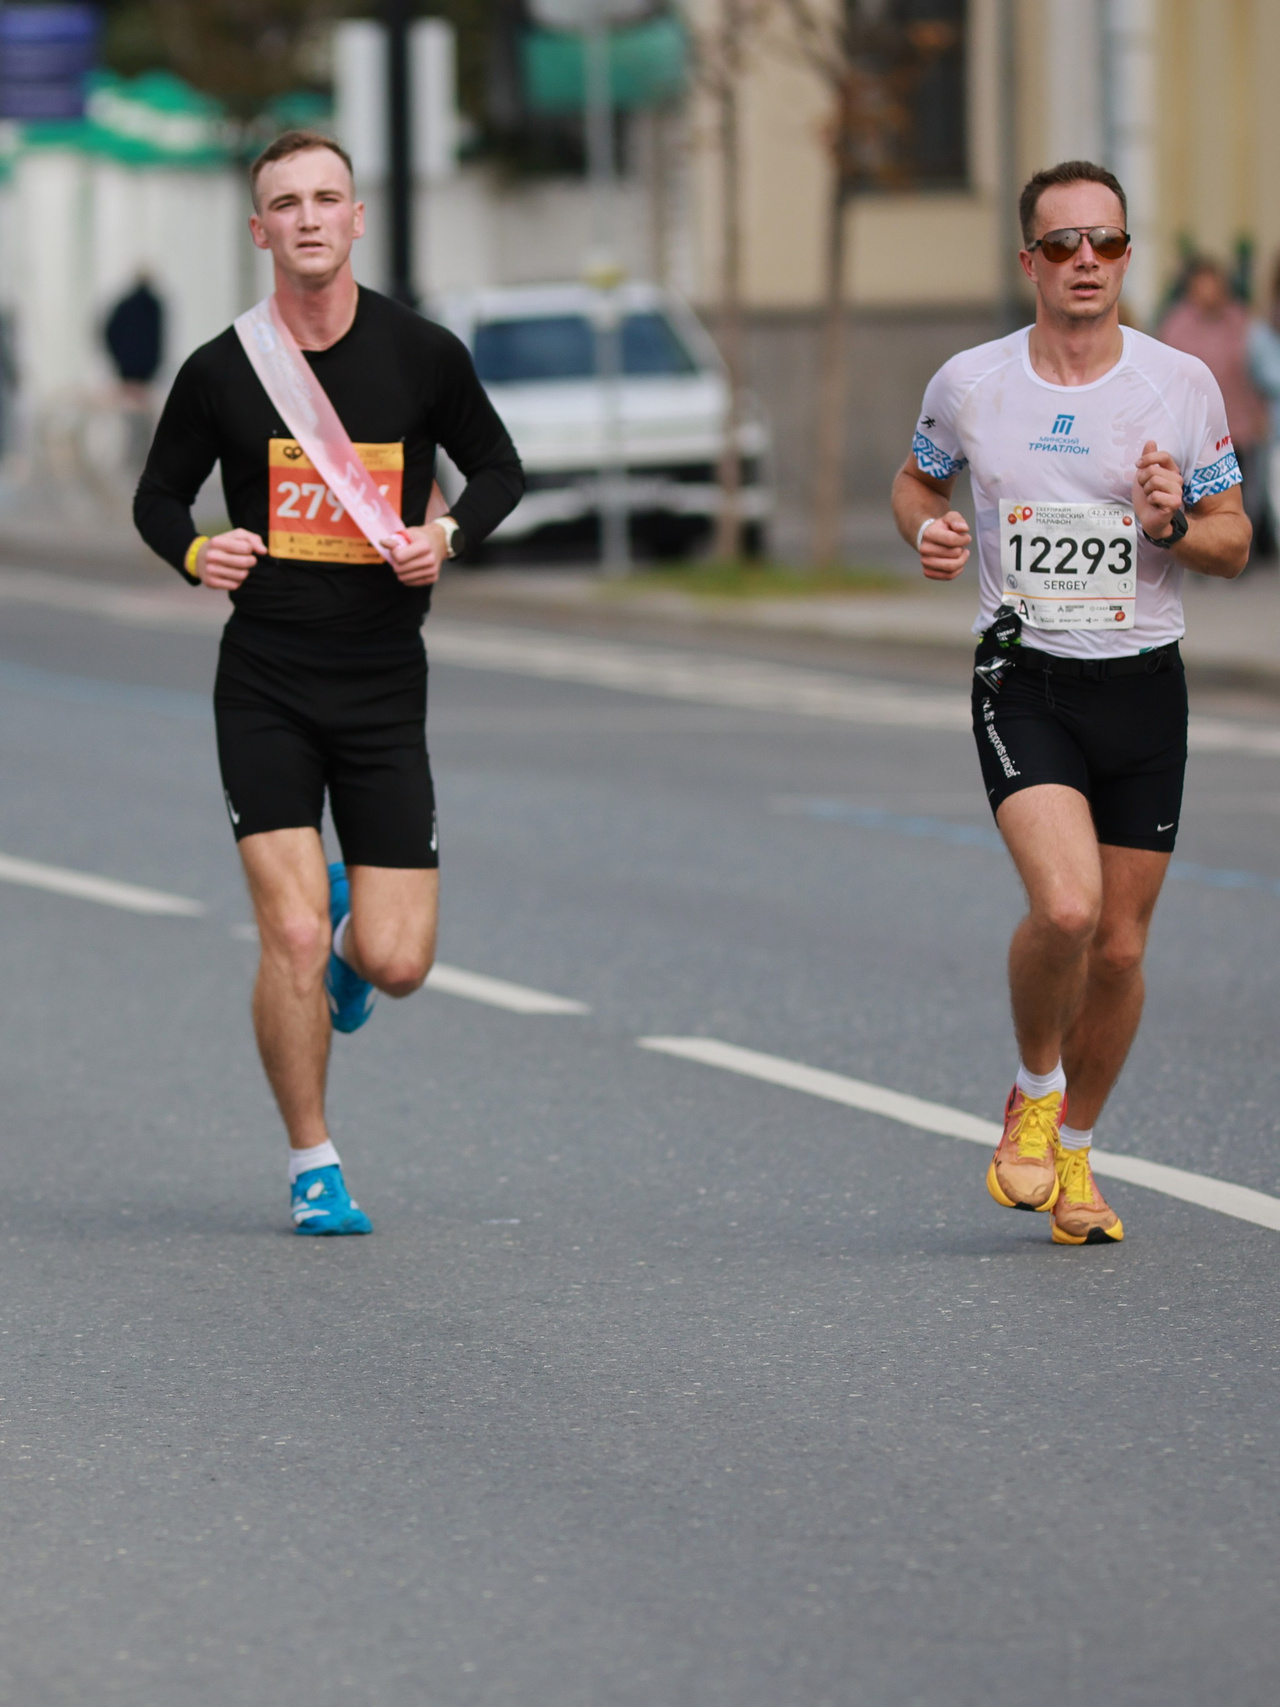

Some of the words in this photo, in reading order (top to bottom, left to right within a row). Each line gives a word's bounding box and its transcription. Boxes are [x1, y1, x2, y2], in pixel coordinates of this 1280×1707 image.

[1029, 443, 1090, 455] ТРИАТЛОН
[1009, 534, 1132, 575] 12293
[1044, 580, 1088, 590] SERGEY
